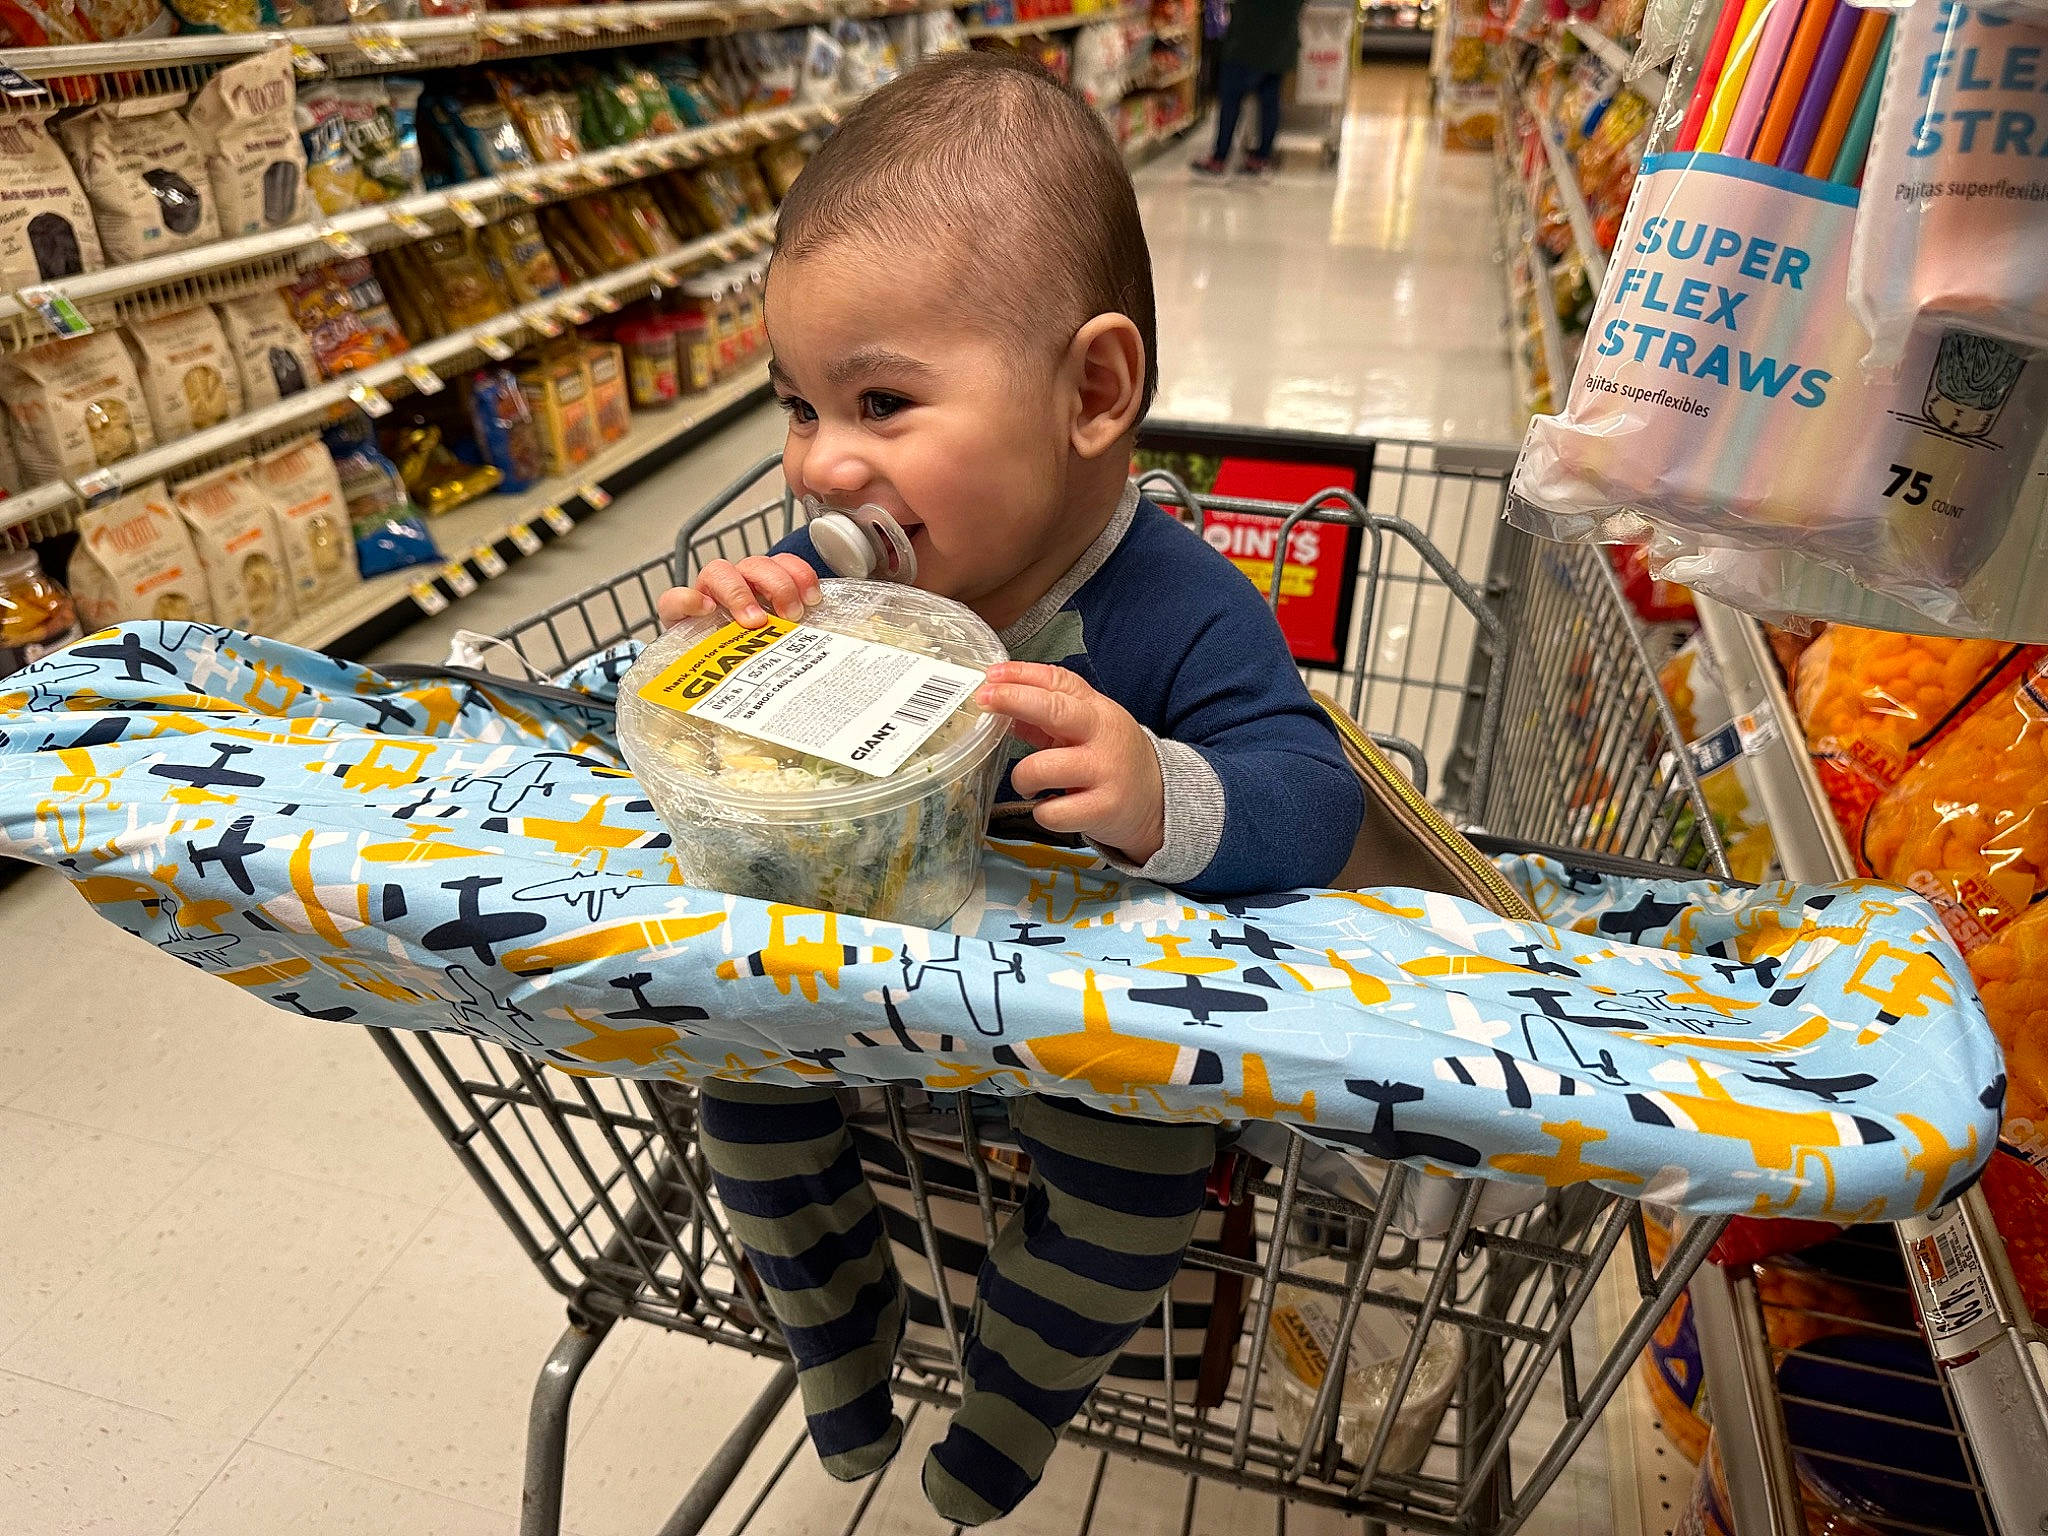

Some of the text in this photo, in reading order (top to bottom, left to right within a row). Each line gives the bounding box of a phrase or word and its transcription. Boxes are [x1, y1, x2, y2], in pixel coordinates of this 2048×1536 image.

[1919, 45, 2048, 98] FLE
[1895, 180, 1942, 200] Pajitas
[1634, 216, 1811, 290] SUPER
[1614, 268, 1749, 331] FLEX
[1597, 319, 1833, 408] STRAWS
[1620, 384, 1710, 419] superflexibles
[1882, 463, 1967, 519] 75 COUNT
[663, 627, 758, 693] thank you for shoppin
[682, 625, 784, 699] GIANT
[754, 691, 775, 711] BROC
[774, 678, 792, 693] CAUL
[791, 663, 813, 680] SALAD
[812, 650, 830, 665] BULK
[850, 722, 896, 761] GIANT
